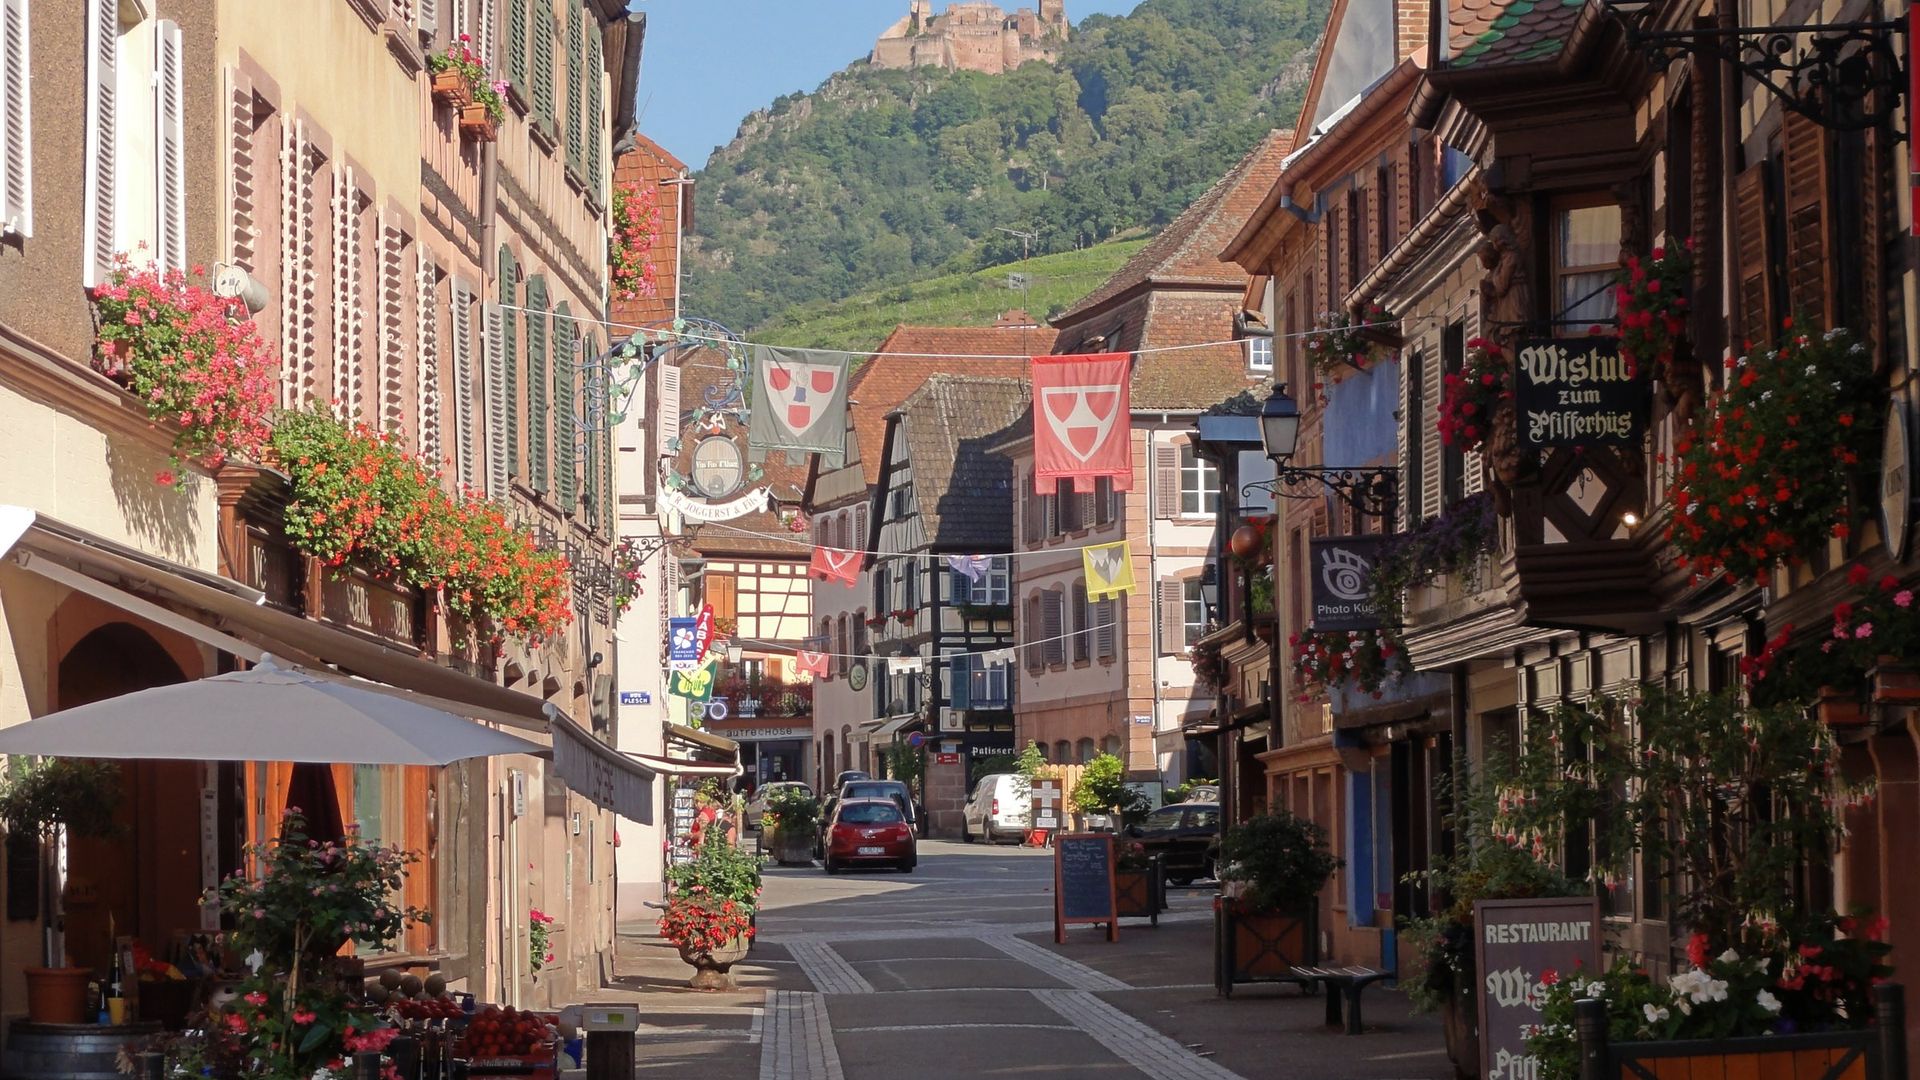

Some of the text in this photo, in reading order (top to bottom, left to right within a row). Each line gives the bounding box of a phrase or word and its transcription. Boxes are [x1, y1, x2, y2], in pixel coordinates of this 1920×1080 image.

[1558, 389, 1600, 405] zum
[1527, 410, 1632, 443] Pfifferhüs
[1317, 603, 1351, 615] Photo
[1485, 921, 1591, 944] RESTAURANT
